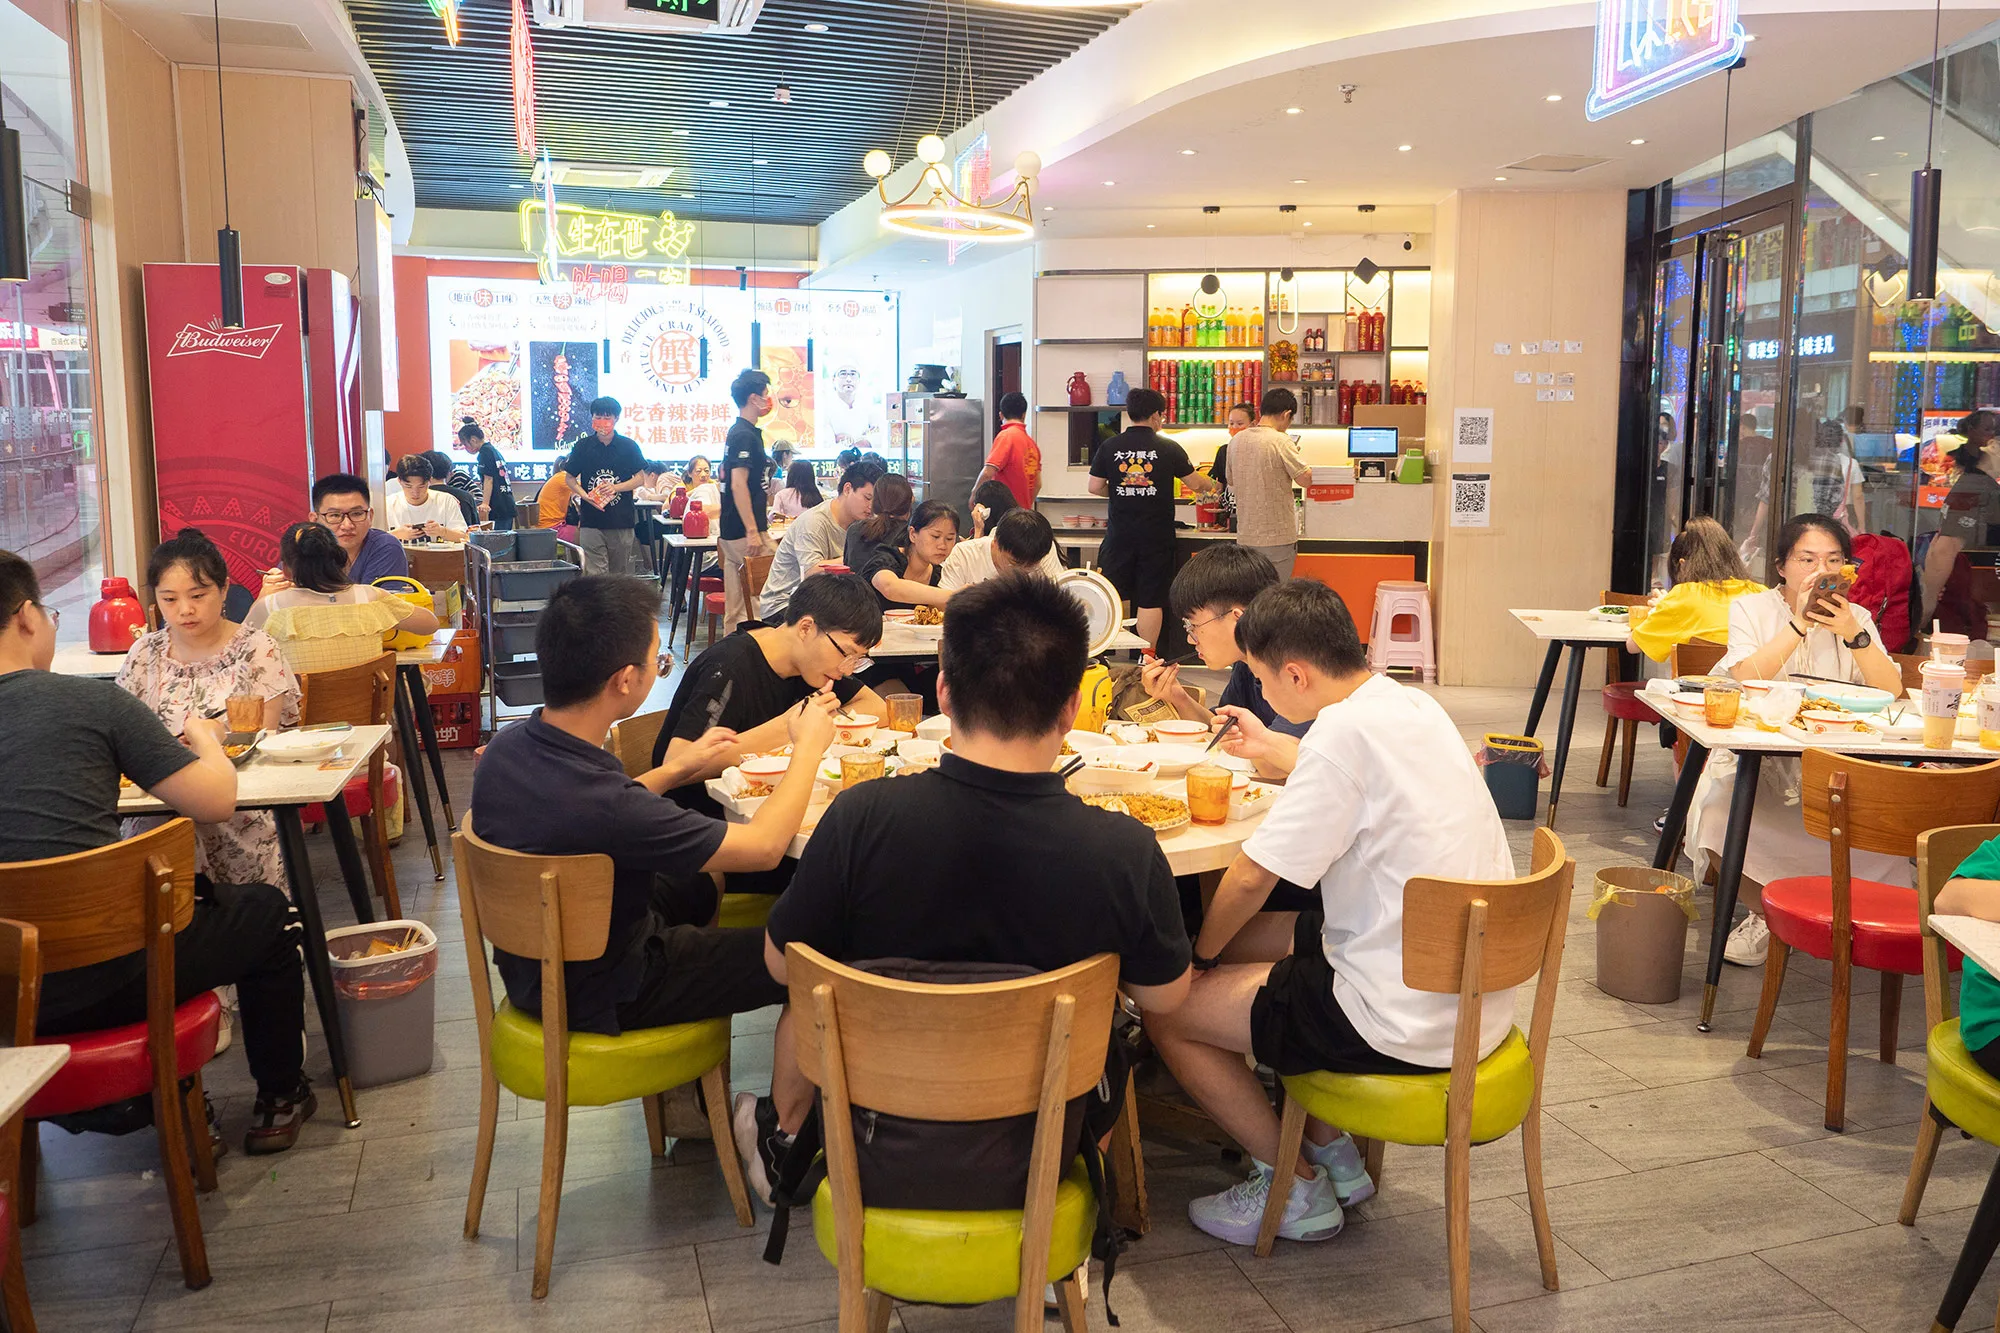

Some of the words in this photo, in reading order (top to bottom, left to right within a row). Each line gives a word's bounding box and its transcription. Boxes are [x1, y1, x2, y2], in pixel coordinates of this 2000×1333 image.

[621, 305, 665, 345] DELICIOUS
[659, 320, 694, 332] CRAB
[176, 331, 270, 349] Budweiser
[624, 402, 732, 422] 吃香辣海鲜
[1114, 450, 1158, 461] 大力蟹手
[1116, 486, 1158, 496] 无蟹可击
